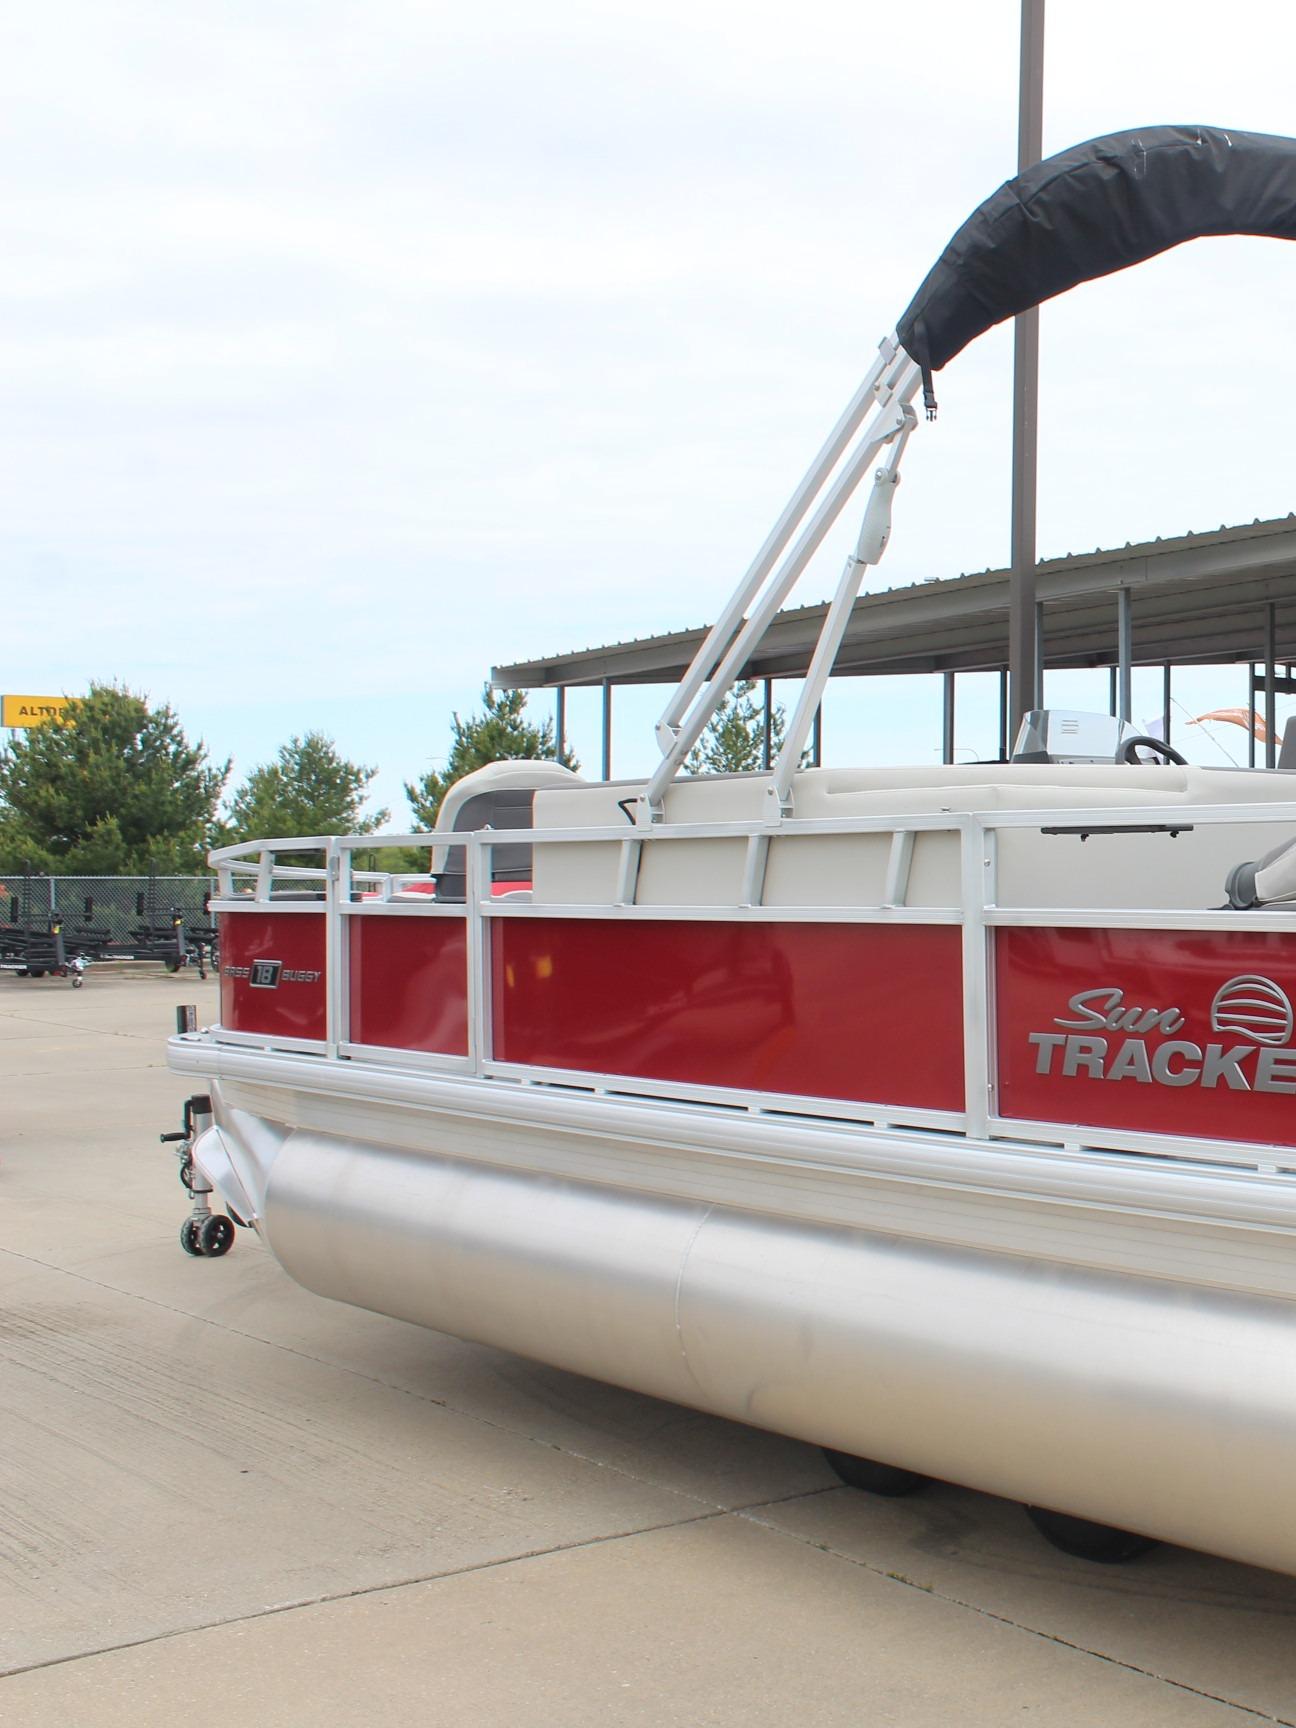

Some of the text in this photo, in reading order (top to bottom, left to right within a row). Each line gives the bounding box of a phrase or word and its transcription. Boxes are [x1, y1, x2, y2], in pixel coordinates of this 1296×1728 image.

[257, 966, 273, 984] 18
[282, 969, 321, 982] BUGGY
[1054, 988, 1185, 1034] Sun
